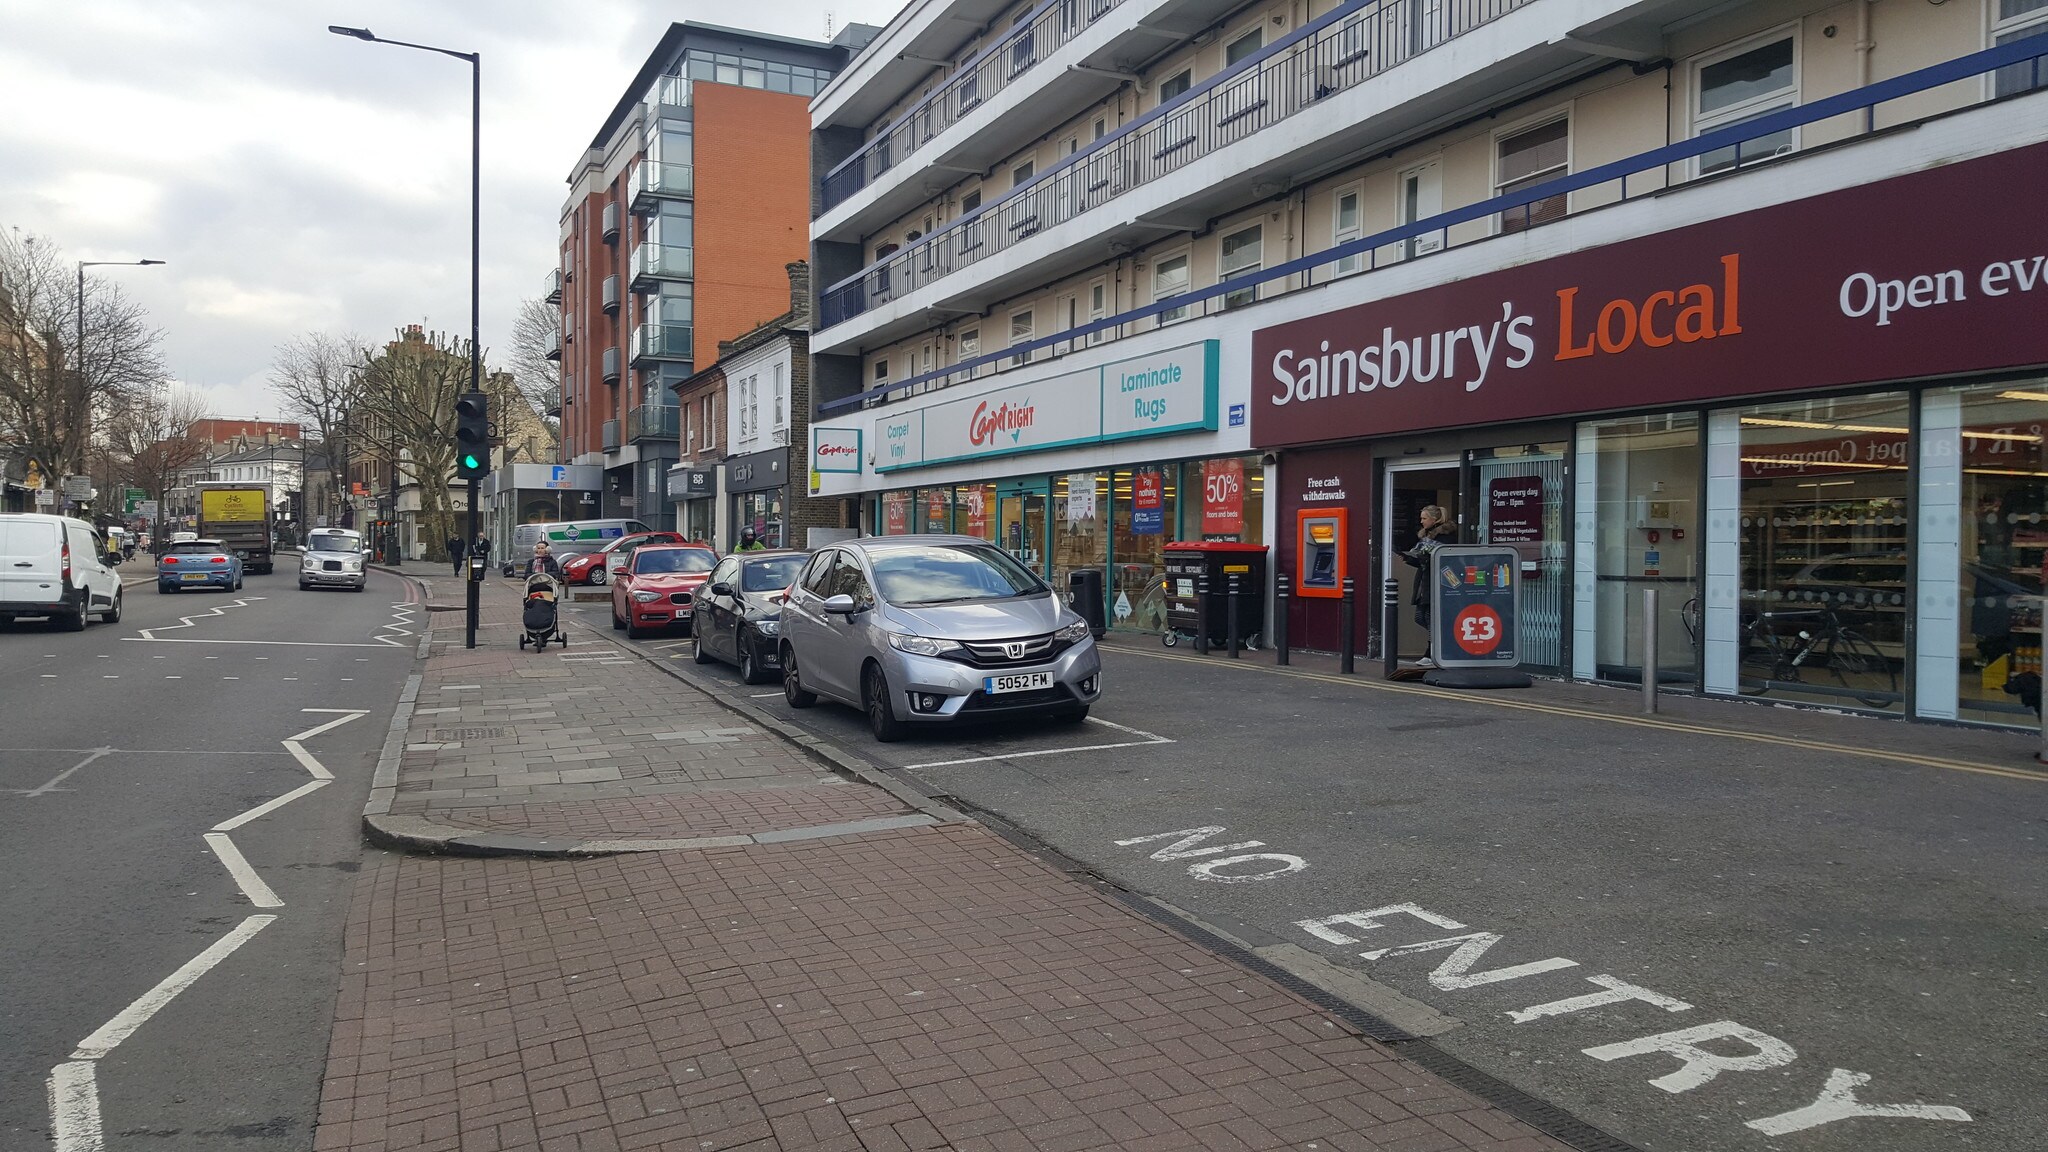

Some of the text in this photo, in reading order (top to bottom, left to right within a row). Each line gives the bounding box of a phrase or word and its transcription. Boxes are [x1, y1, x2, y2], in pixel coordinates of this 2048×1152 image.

[1839, 255, 2048, 327] Open ev
[1271, 252, 1743, 406] Sainsbury's Local
[1121, 362, 1182, 393] Laminate
[1134, 397, 1166, 422] Rugs
[887, 420, 909, 441] Carpet
[890, 442, 906, 460] Vinyl
[1206, 474, 1238, 503] 50%
[1307, 475, 1340, 488] Free cash
[1493, 488, 1538, 498] Open every day
[1302, 489, 1346, 501] withdrawals
[1461, 616, 1496, 641] £3
[998, 673, 1048, 690] 5052 FM
[1114, 825, 1309, 884] NO
[1293, 902, 1974, 1138] ENTRY
